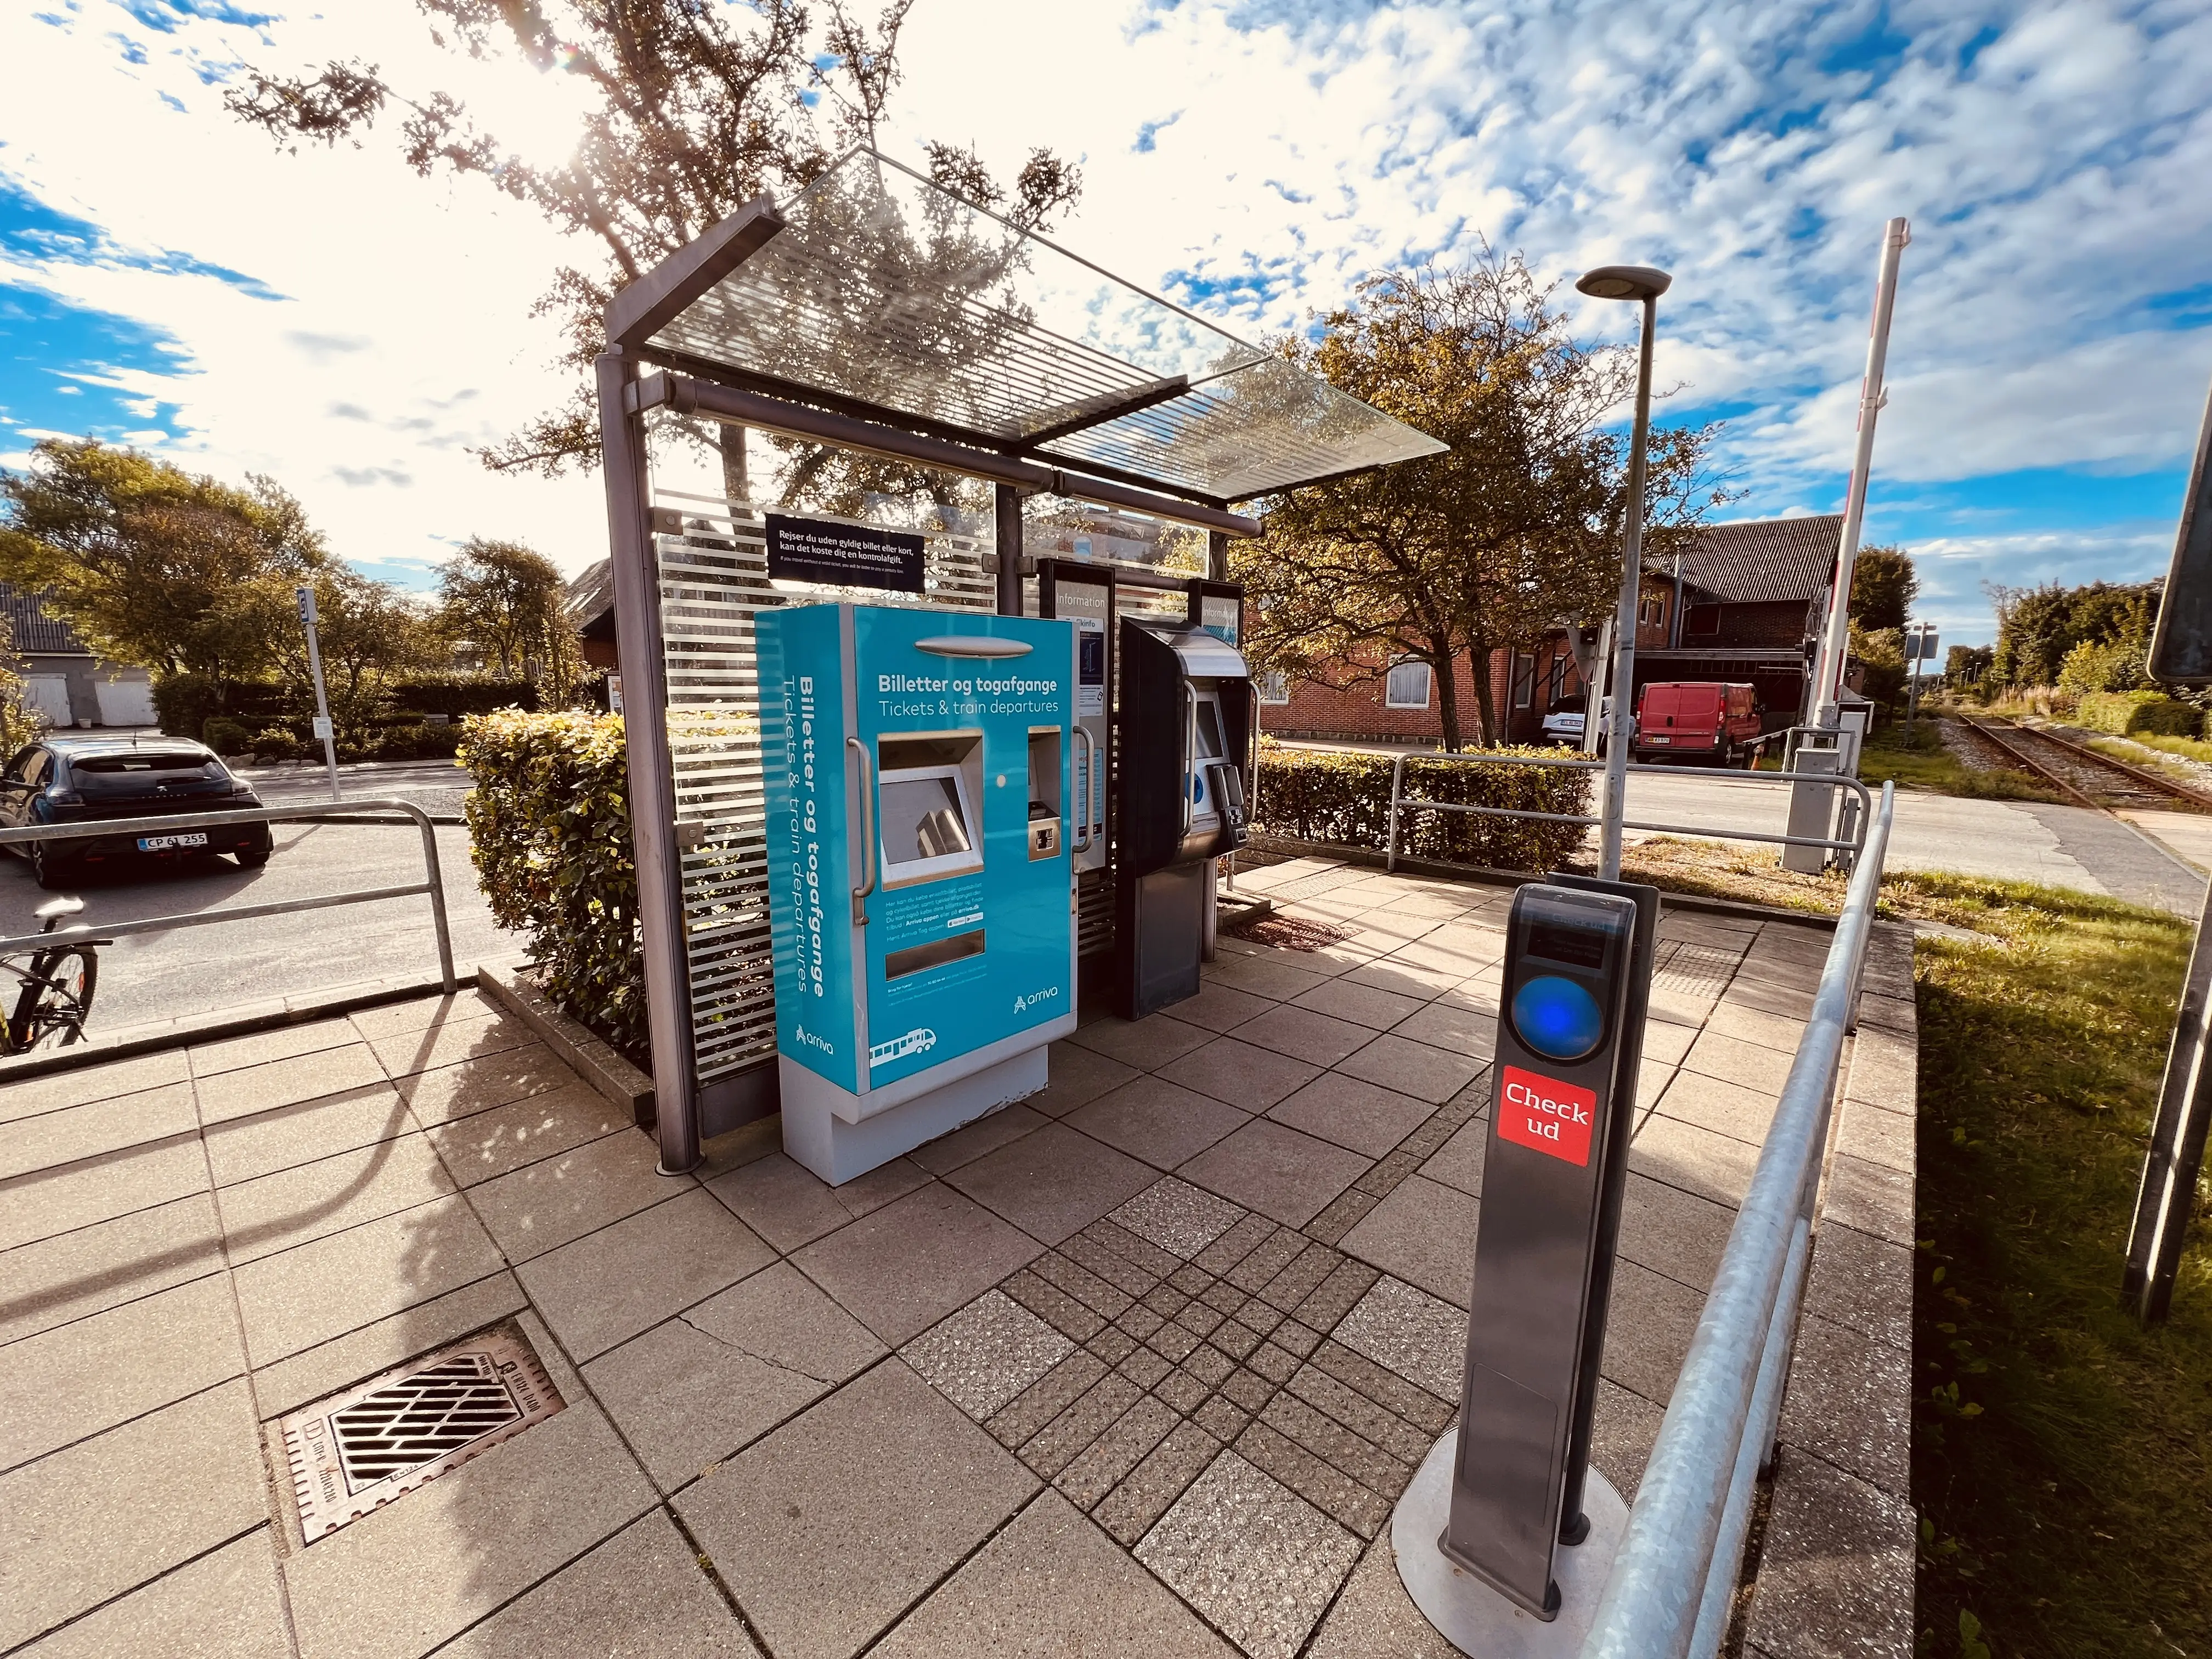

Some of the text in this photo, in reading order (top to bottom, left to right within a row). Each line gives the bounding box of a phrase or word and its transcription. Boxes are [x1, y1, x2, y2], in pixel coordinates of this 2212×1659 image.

[779, 530, 913, 556] Rejser du uden gyldig billet eller kort,
[780, 541, 795, 551] kan
[797, 544, 810, 553] det
[811, 545, 833, 556] koste
[834, 548, 847, 558] dig
[858, 551, 903, 565] kontrolafgift.
[1057, 592, 1105, 608] Information
[878, 674, 1057, 696] Billetter og togafgange
[878, 699, 1058, 716] Tickets & train departures
[148, 838, 163, 847] CP
[184, 834, 205, 844] 255
[783, 675, 806, 992] Tickets & train departures
[799, 676, 823, 997] Billetter og togafgange
[923, 915, 939, 923] appen
[1553, 913, 1587, 927] Check
[1028, 986, 1058, 1005] arriva
[806, 1032, 834, 1056] arriva
[1506, 1082, 1589, 1142] Check ud
